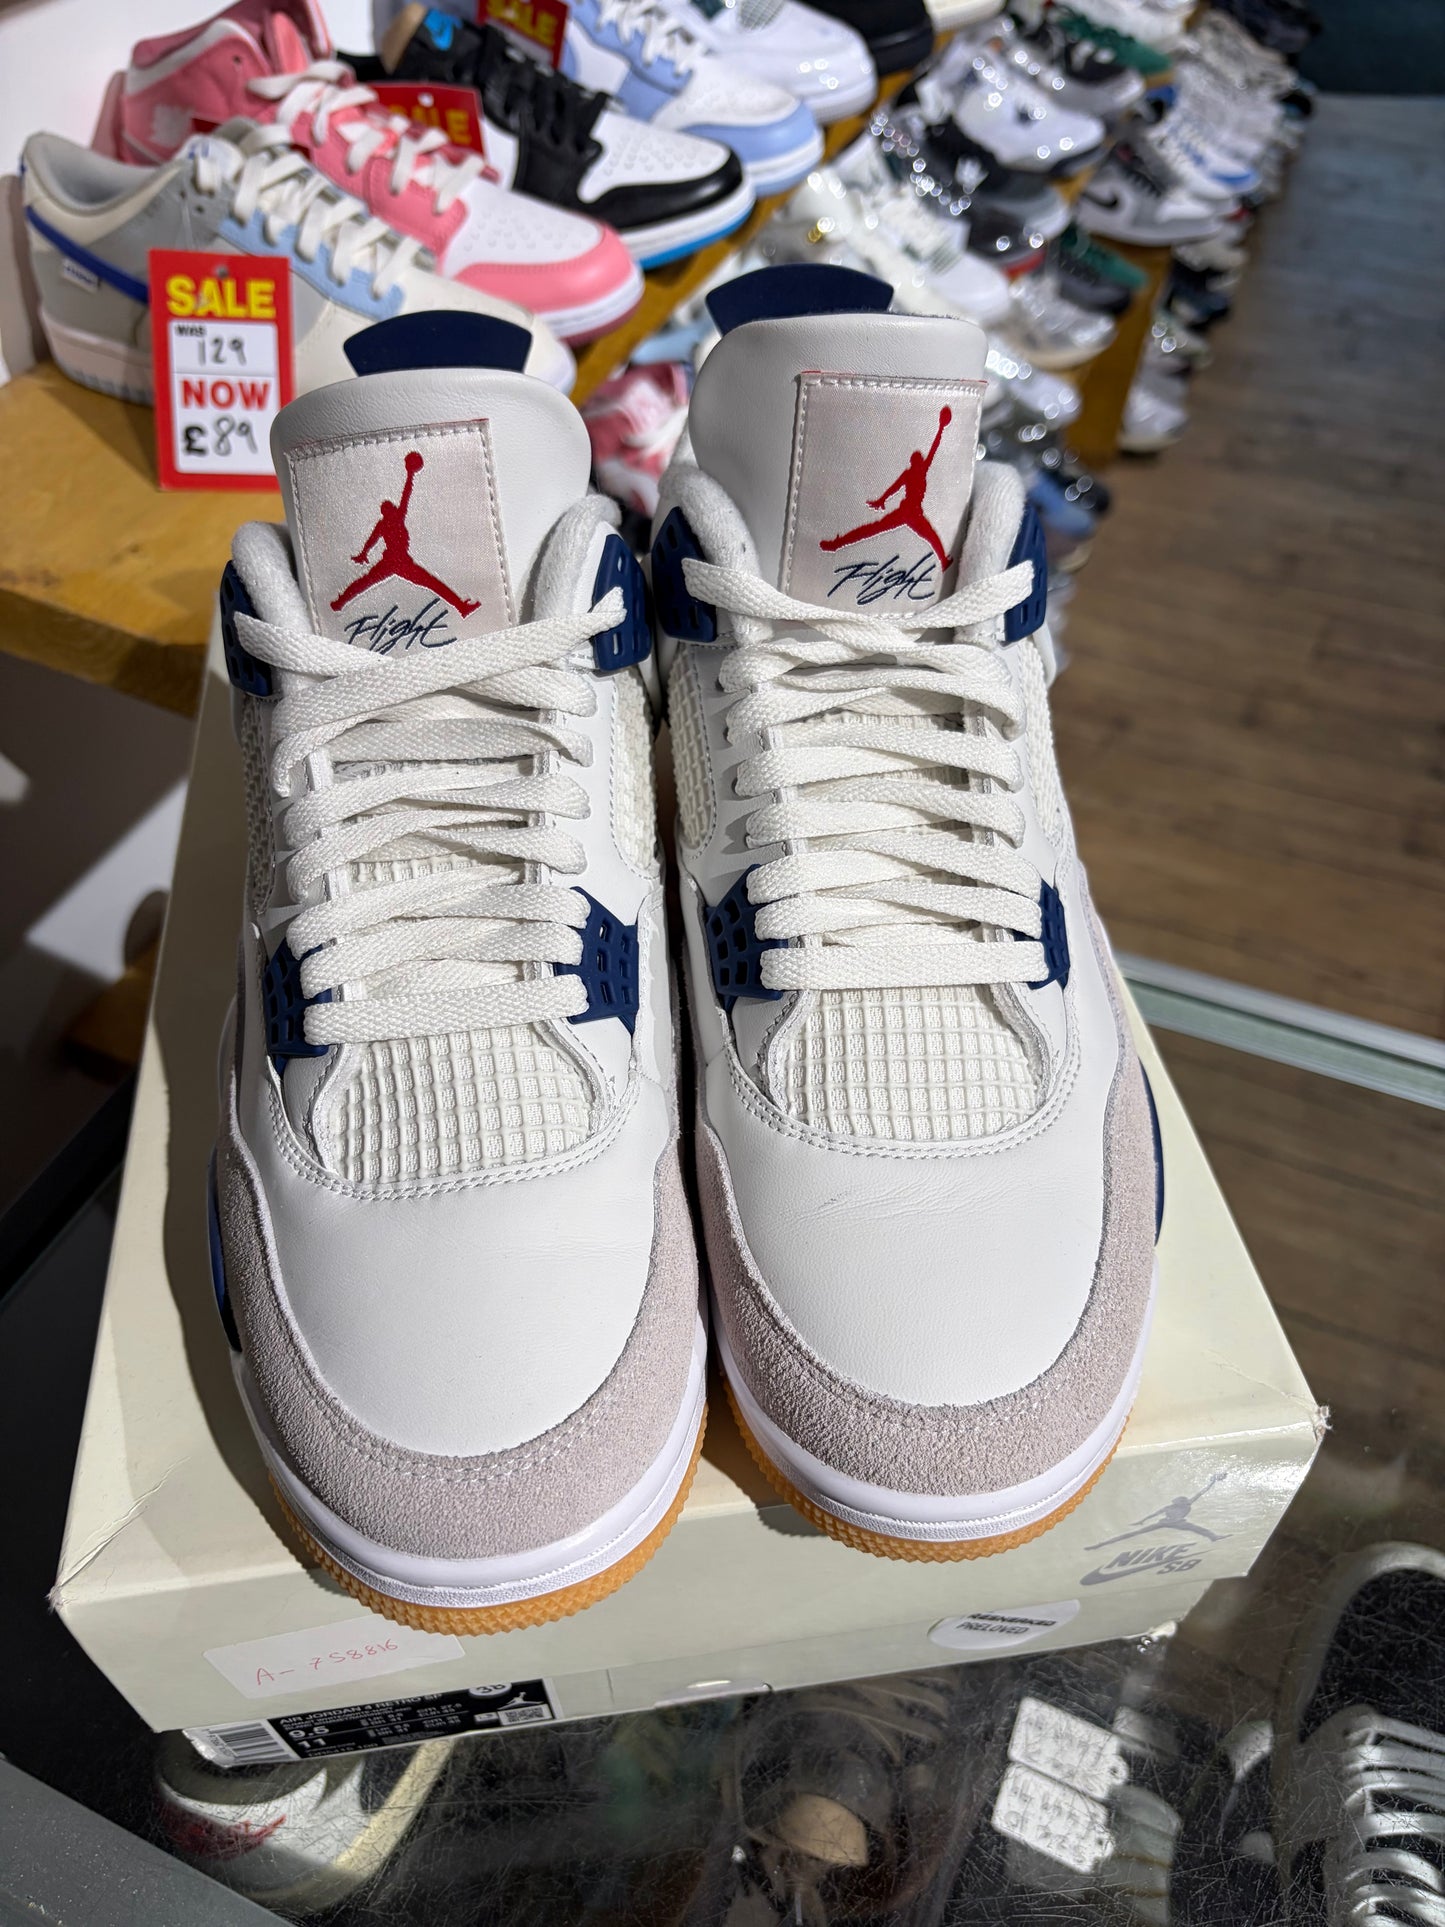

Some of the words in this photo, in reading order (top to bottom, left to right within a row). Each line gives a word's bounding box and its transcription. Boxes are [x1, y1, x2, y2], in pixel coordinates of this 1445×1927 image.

[166, 274, 276, 318] SALE
[198, 337, 247, 366] 129
[181, 379, 270, 411] NOW
[827, 552, 936, 606] Flight
[344, 597, 457, 655] Flight
[1103, 1542, 1197, 1569] NIKE
[1156, 1559, 1202, 1575] SB
[956, 1621, 1030, 1634] PRELOVED
[280, 1715, 302, 1725] AIR
[305, 1706, 361, 1720] JORDAN
[375, 1697, 421, 1709] RETRO
[289, 1726, 329, 1738] 9.5
[298, 1738, 326, 1749] 11
